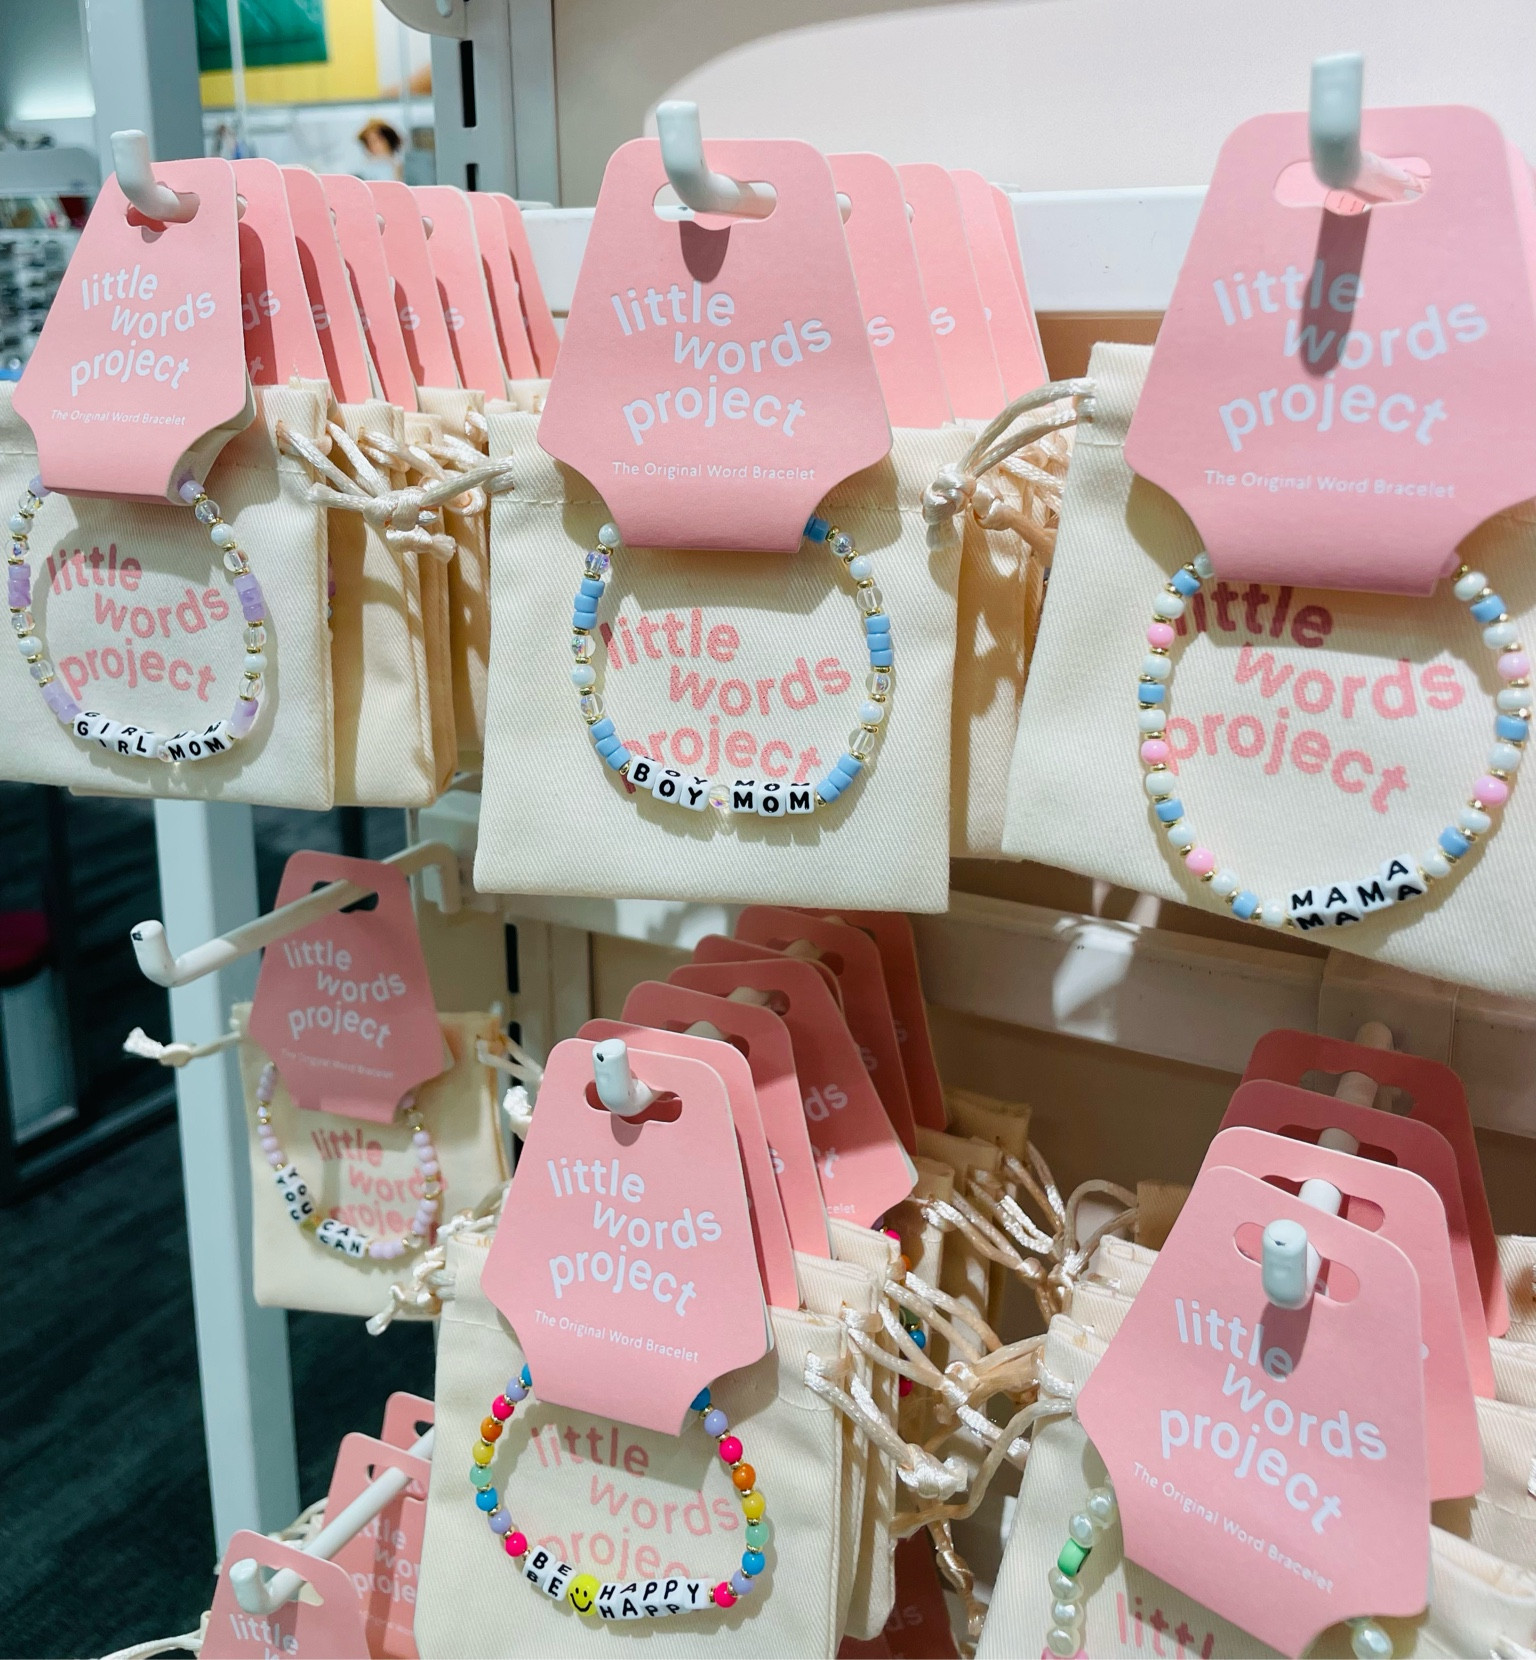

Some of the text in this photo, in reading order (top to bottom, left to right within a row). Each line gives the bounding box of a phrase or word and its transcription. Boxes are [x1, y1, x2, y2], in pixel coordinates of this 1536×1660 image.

[82, 264, 158, 310] little
[611, 280, 735, 335] little
[1213, 259, 1364, 326] little
[111, 291, 216, 339] words
[1283, 302, 1488, 369] words
[71, 340, 190, 396] project
[674, 318, 831, 374] words
[51, 409, 185, 425] The Original Word Bracelet
[623, 375, 806, 445] project
[1218, 370, 1447, 452] project
[612, 462, 815, 480] The Original Word Bracelet
[1204, 469, 1455, 498] The Original Word Bracelet
[46, 543, 142, 594] little
[94, 588, 230, 638] words
[599, 608, 739, 670] little
[59, 638, 216, 701] project
[669, 657, 851, 716] words
[1235, 642, 1465, 720] words
[77, 720, 225, 760] GIRL MOM
[1165, 707, 1410, 814] project
[633, 762, 809, 813] BOY MOM
[1291, 860, 1410, 913] MAMA
[283, 940, 351, 970] little
[317, 970, 406, 1002] words
[288, 1001, 391, 1049] project
[548, 1158, 644, 1203] little
[593, 1200, 722, 1250] words
[549, 1245, 697, 1317] project
[534, 1309, 699, 1363] The Original Word Bracelet
[1175, 1298, 1292, 1382] little
[1222, 1364, 1387, 1460] words
[531, 1423, 650, 1478] little
[1160, 1409, 1342, 1535] project
[590, 1474, 739, 1536] words
[1134, 1461, 1333, 1594] The Original Word Bracelet
[531, 1551, 699, 1612] BE HAPPY
[229, 1614, 299, 1656] little
